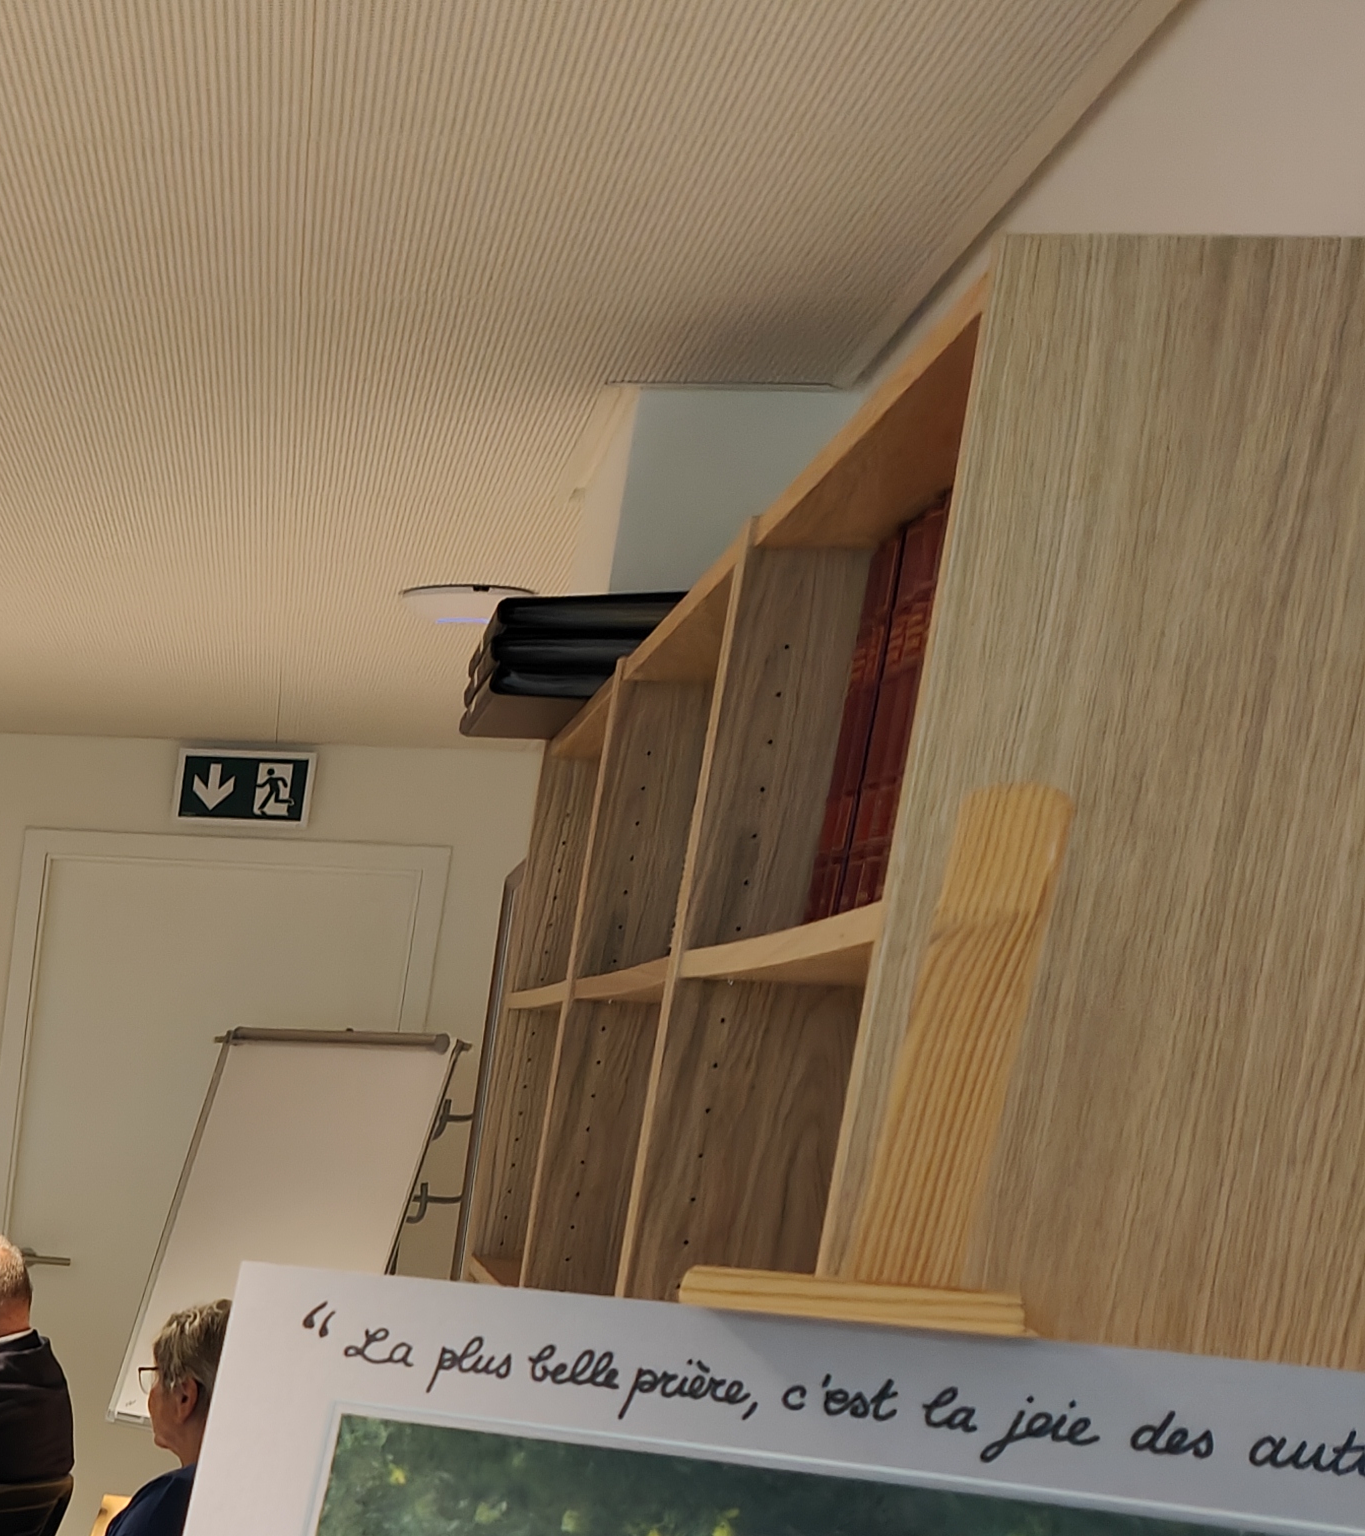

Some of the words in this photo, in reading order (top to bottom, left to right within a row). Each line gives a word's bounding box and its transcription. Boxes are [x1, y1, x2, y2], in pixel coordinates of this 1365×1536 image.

[425, 1336, 512, 1393] plus
[529, 1344, 620, 1390] belle
[781, 1373, 899, 1422] c'est
[922, 1386, 978, 1433] la
[979, 1394, 1101, 1464] joie
[1130, 1410, 1215, 1460] des
[1248, 1428, 1365, 1477] aut
